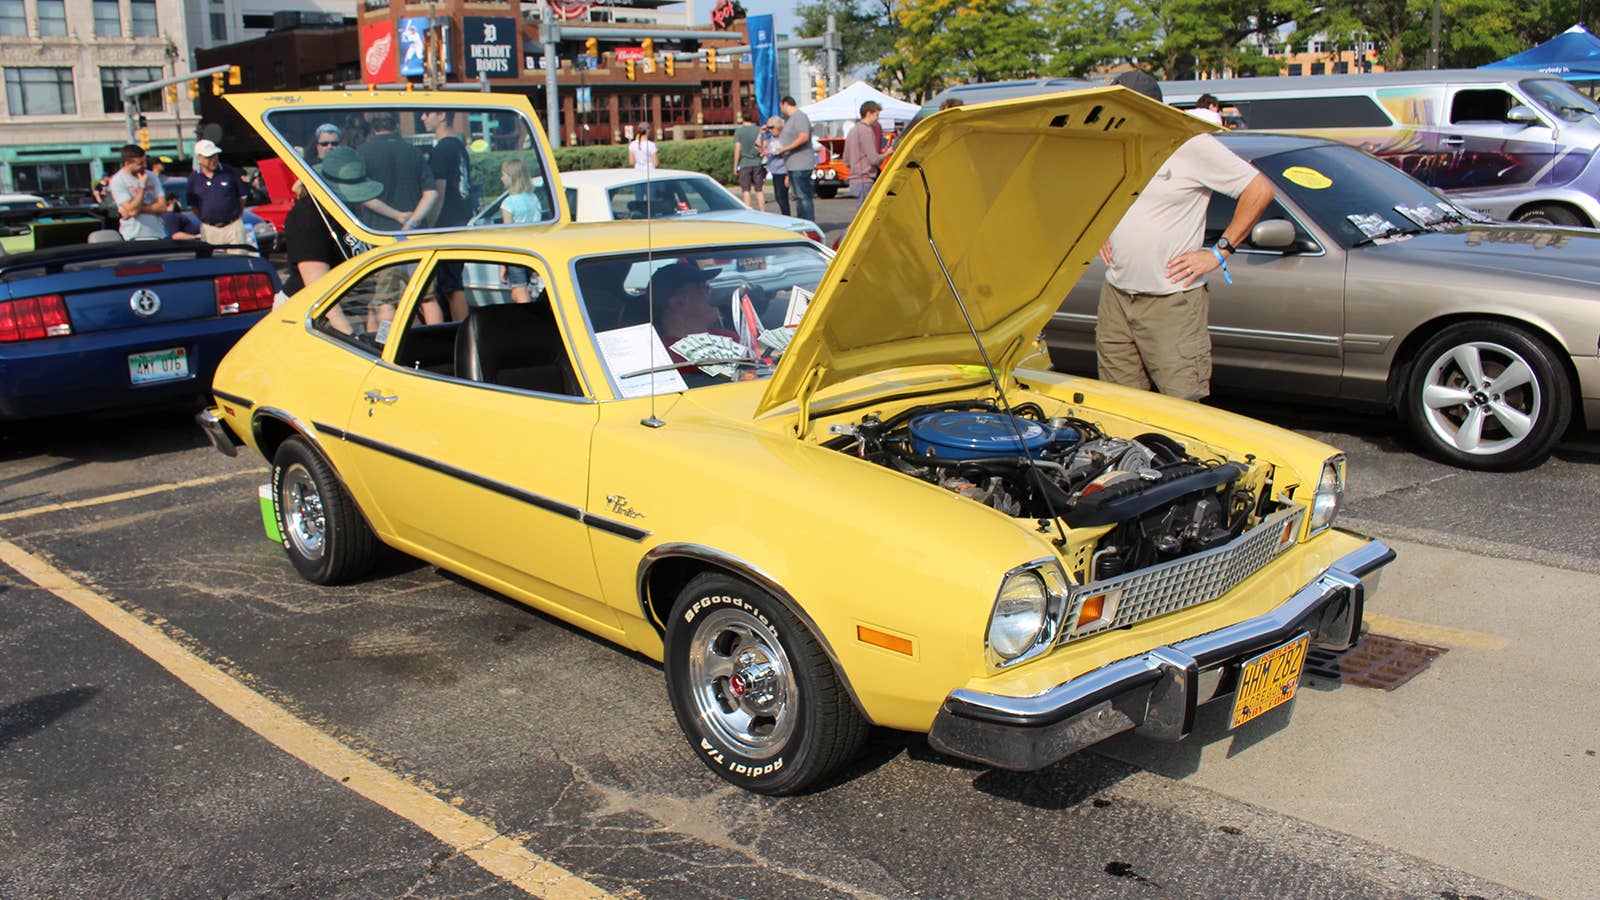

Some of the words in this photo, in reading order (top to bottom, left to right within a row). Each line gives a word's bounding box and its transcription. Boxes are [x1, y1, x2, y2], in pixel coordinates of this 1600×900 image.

[470, 44, 511, 58] DETROIT
[476, 58, 509, 72] ROOTS
[612, 495, 647, 519] Pinto
[684, 595, 779, 639] BFGoodrich
[1239, 659, 1272, 701] HHM
[1272, 643, 1302, 684] 282
[700, 737, 725, 764] T/A
[729, 757, 784, 777] Radial
